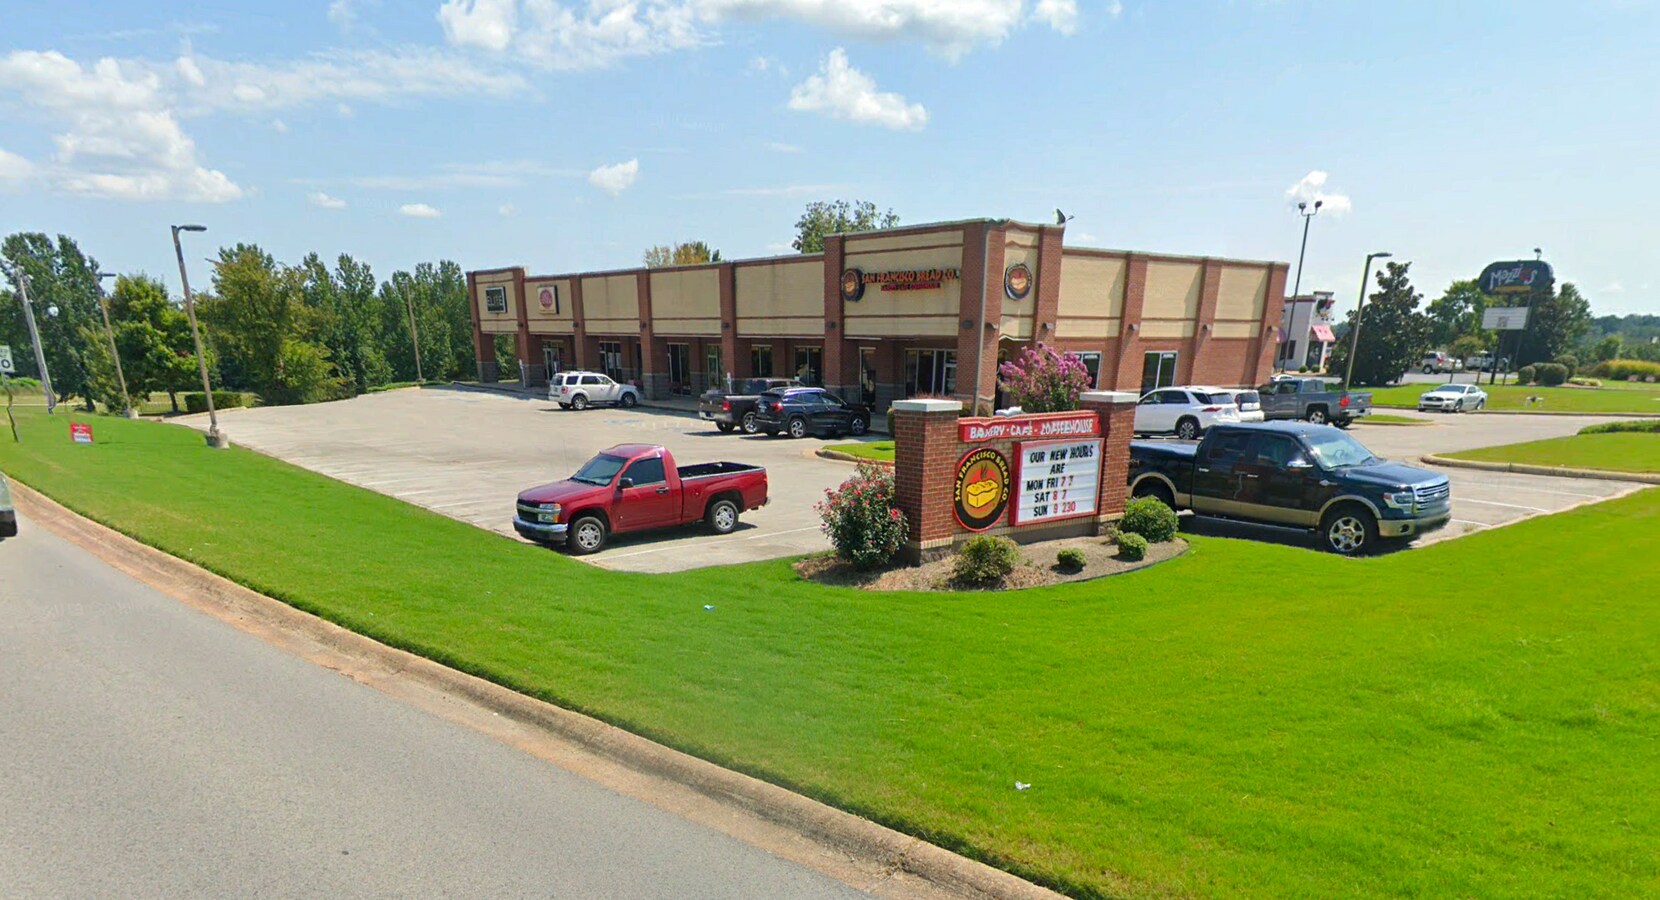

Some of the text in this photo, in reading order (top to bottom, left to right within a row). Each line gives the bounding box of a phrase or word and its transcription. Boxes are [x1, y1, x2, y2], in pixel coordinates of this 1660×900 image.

[862, 273, 876, 284] SAN
[970, 425, 1005, 439] BAKERY
[1030, 445, 1094, 463] OUR NEW HOURS
[958, 451, 996, 479] FRANCISCO
[995, 456, 1010, 485] BREAD
[1050, 463, 1065, 475] ARE
[1026, 475, 1074, 491] MON FRI 7 7
[1034, 489, 1067, 503] SAT 8 7
[1033, 501, 1076, 517] SUN 9 230
